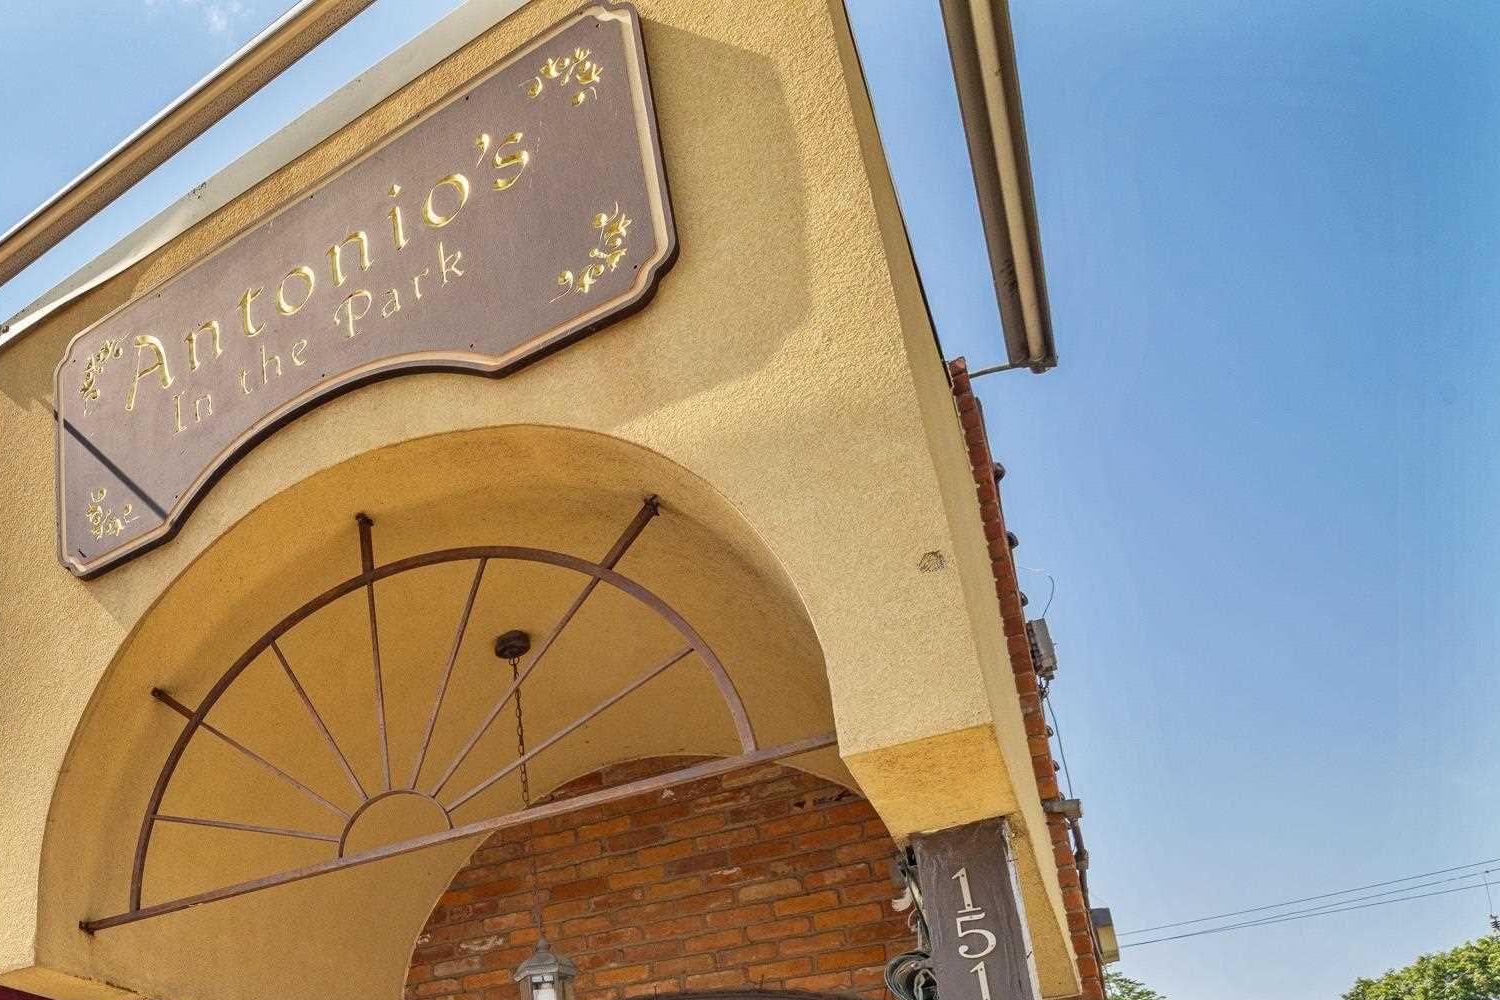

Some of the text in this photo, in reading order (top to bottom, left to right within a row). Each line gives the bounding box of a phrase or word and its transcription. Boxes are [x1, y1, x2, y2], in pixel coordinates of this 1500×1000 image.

[125, 131, 531, 411] Antonio's
[171, 240, 466, 436] In the Park
